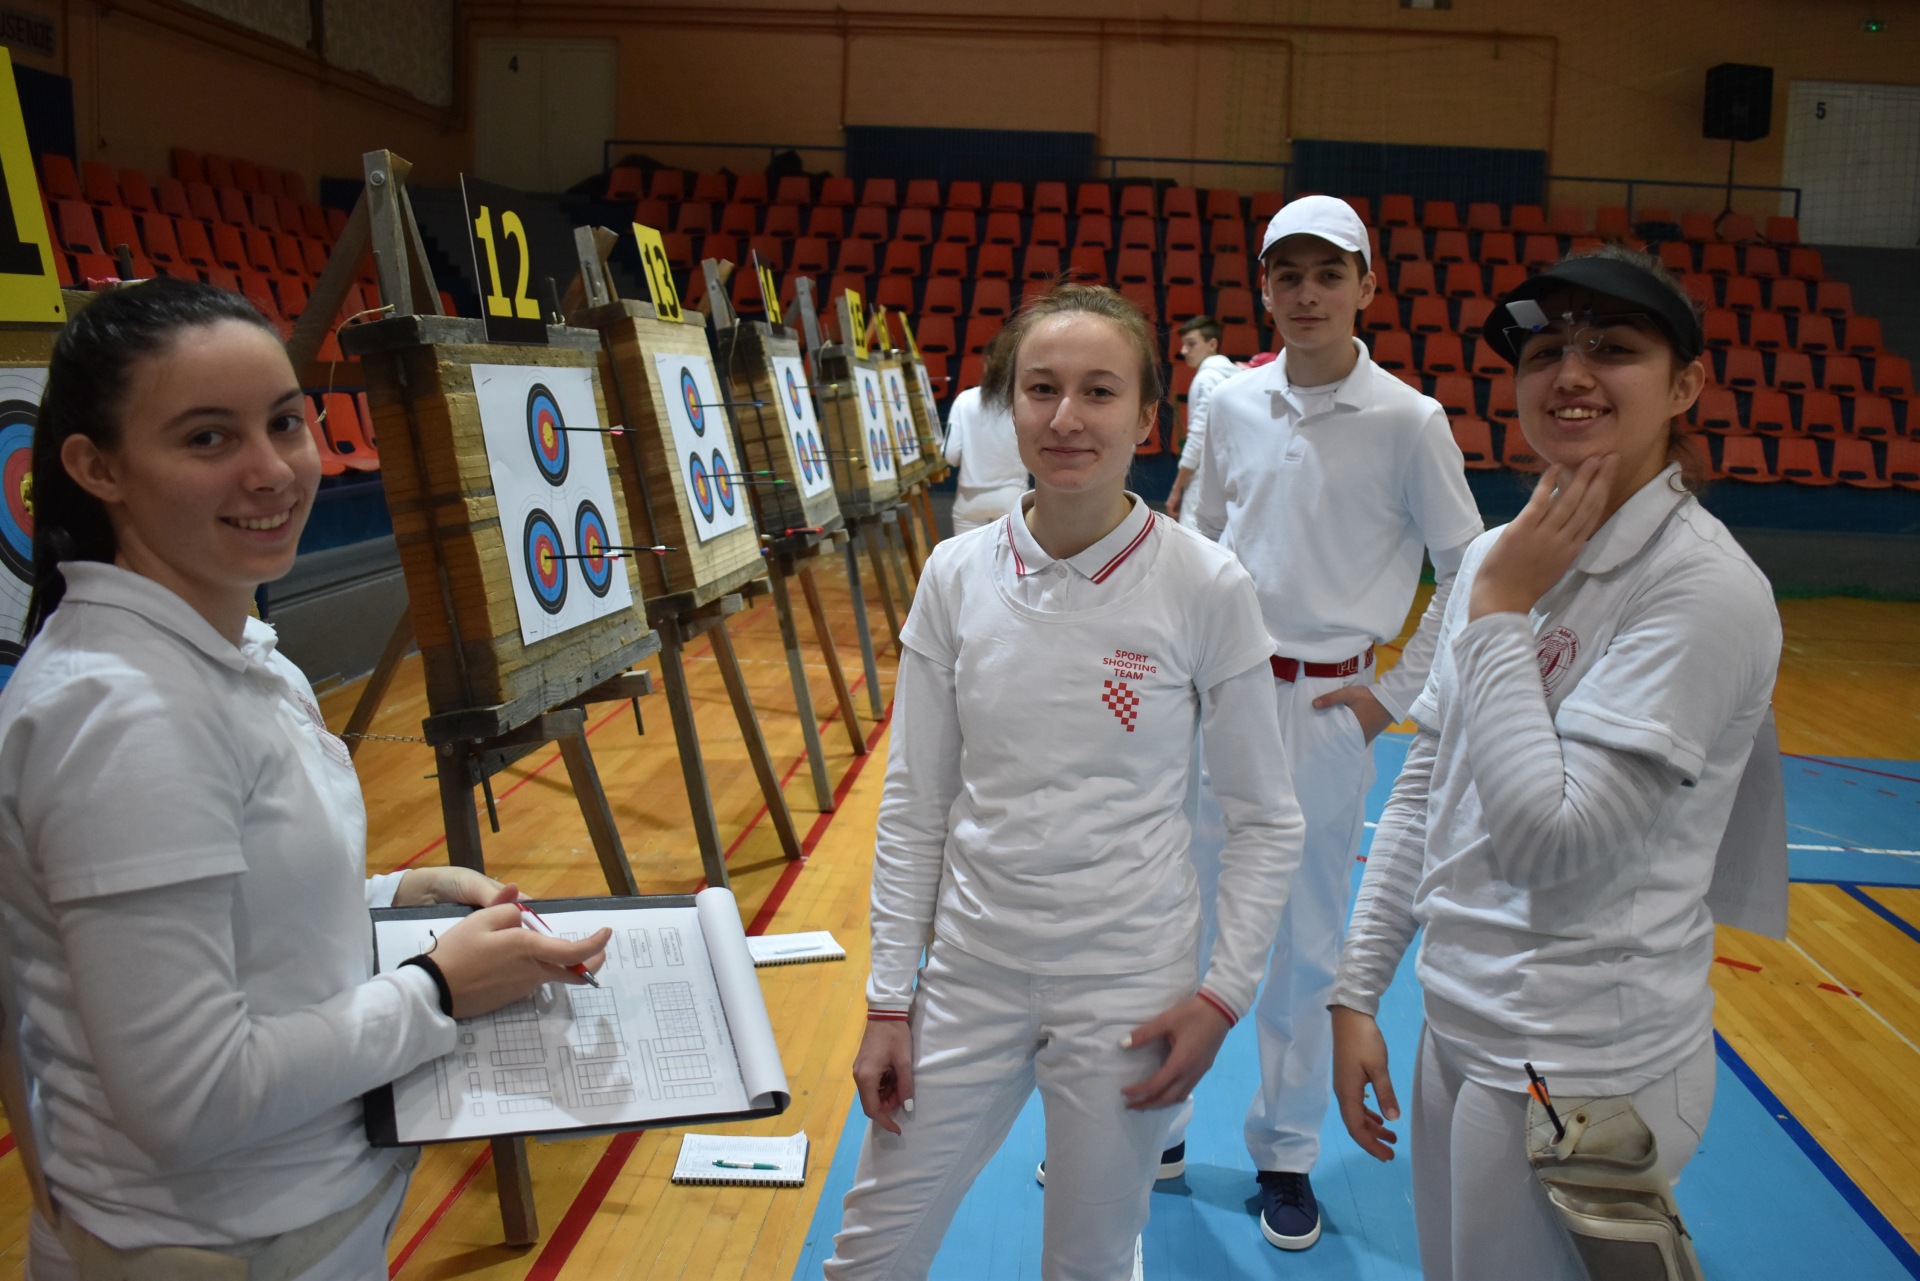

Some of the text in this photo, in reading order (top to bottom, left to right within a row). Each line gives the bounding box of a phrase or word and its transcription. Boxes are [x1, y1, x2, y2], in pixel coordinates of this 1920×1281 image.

[508, 55, 519, 73] 4
[1816, 101, 1827, 120] 5
[474, 205, 541, 320] 12
[643, 242, 680, 319] 13
[1115, 649, 1149, 663] SPORT
[1102, 657, 1157, 674] SHOOTING
[1113, 668, 1144, 681] TEAM
